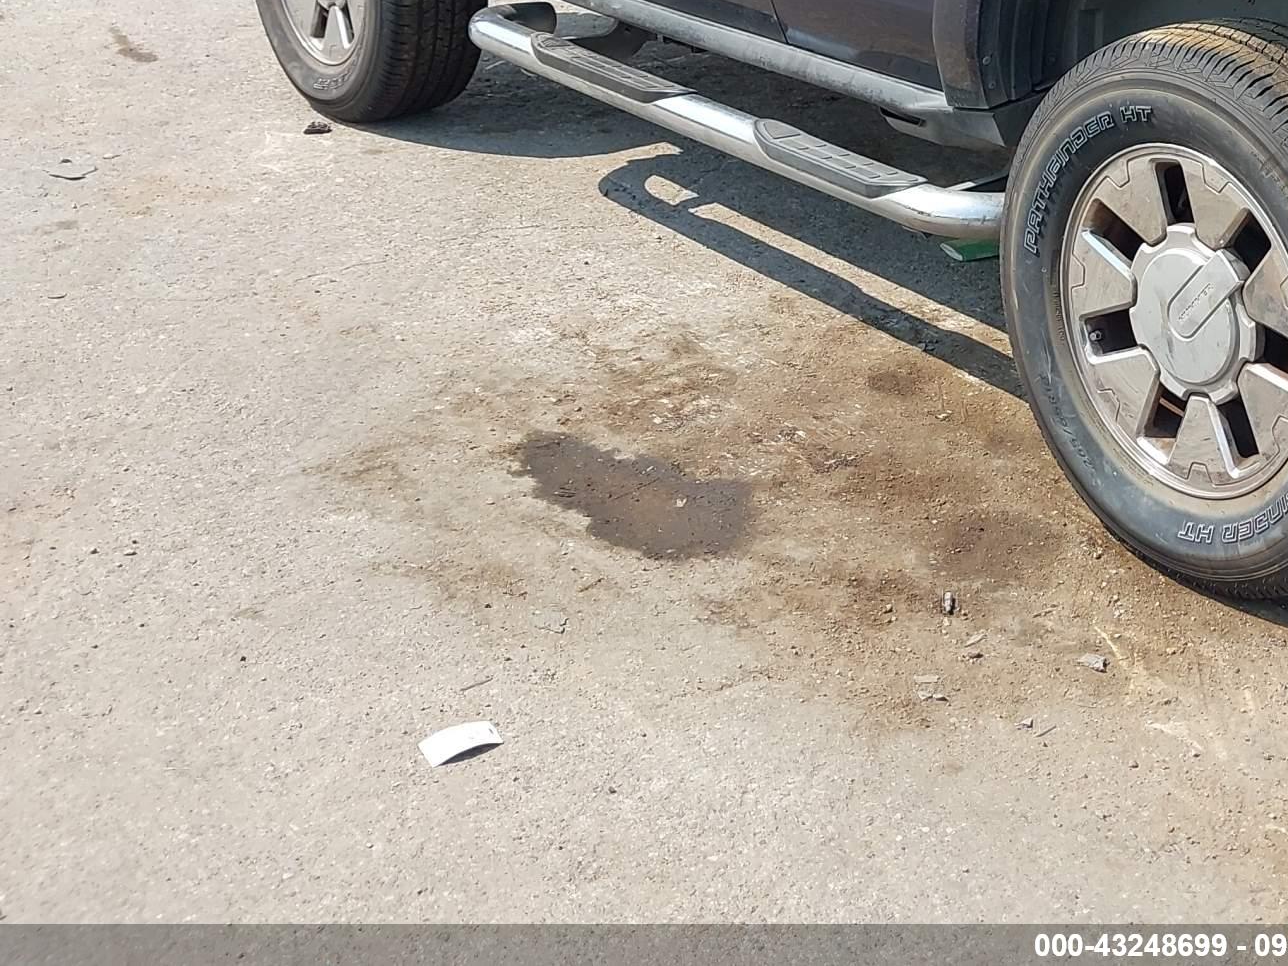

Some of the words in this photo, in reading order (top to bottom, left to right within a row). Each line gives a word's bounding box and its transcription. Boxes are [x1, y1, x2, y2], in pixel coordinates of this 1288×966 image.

[1024, 111, 1115, 255] PATHFINDER
[1120, 106, 1152, 123] HT
[1178, 521, 1214, 544] HT
